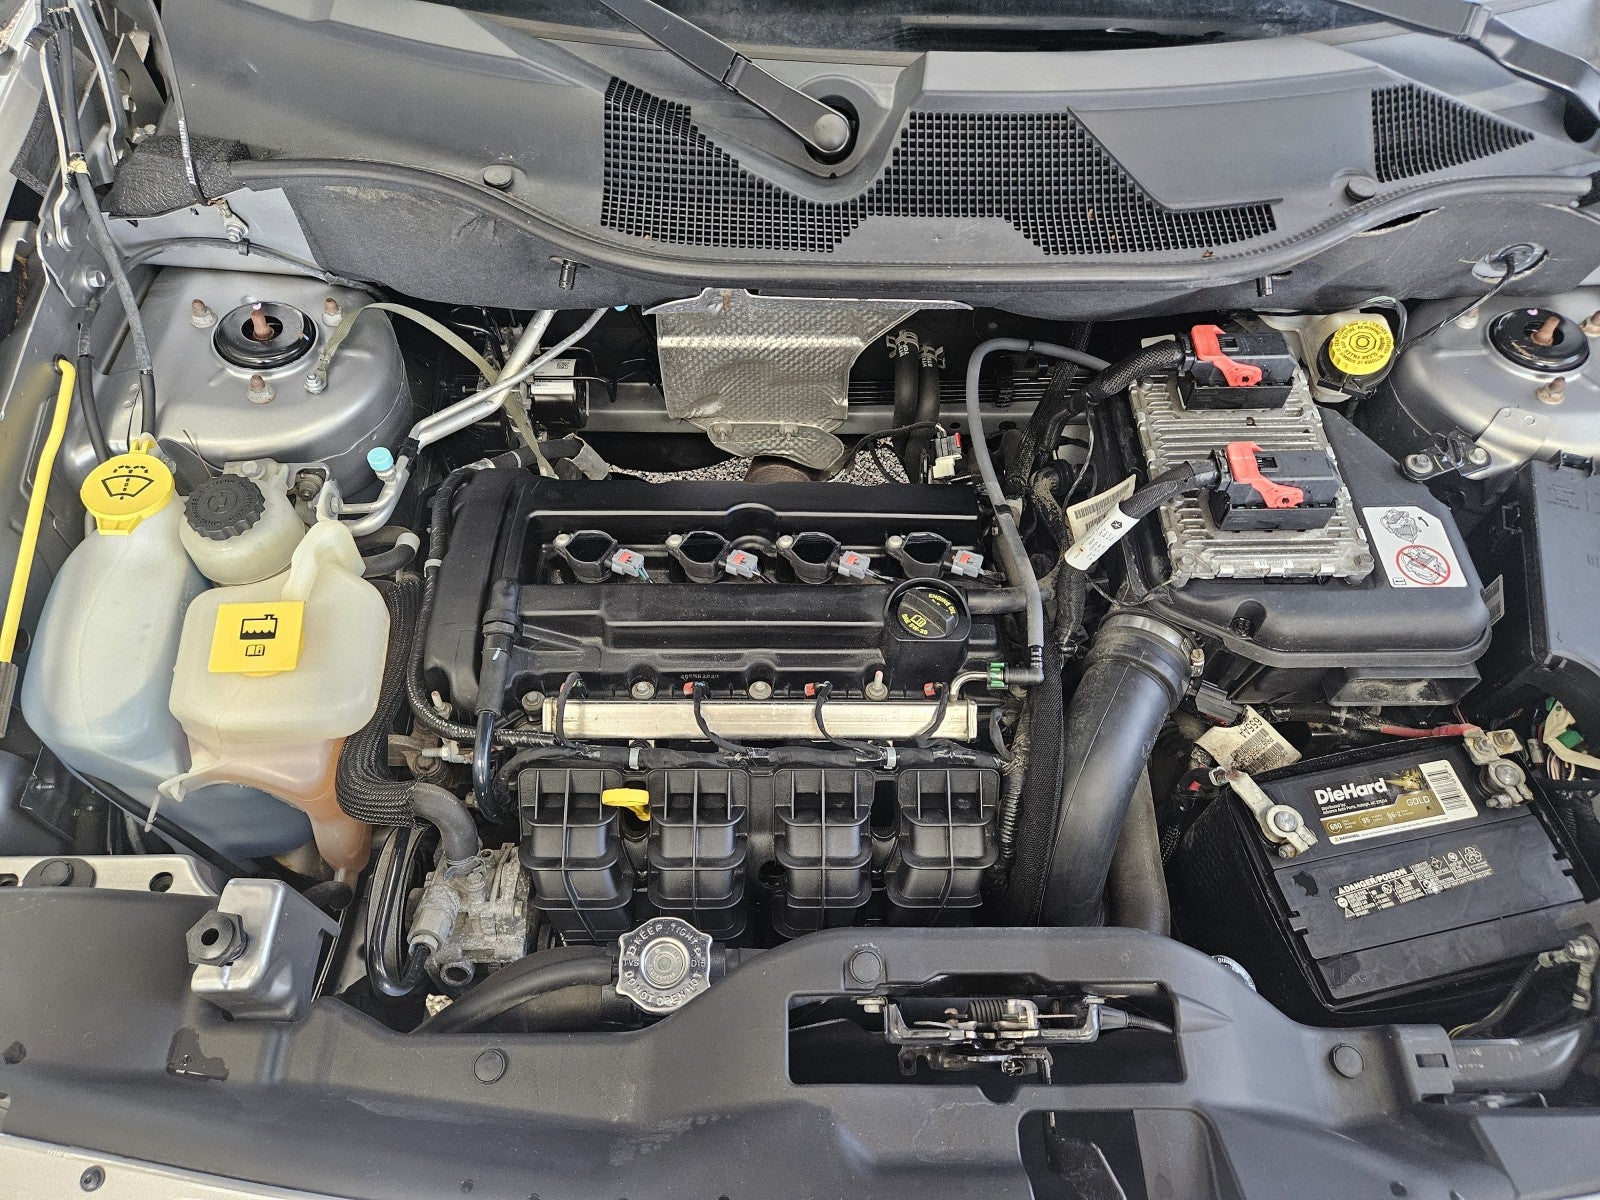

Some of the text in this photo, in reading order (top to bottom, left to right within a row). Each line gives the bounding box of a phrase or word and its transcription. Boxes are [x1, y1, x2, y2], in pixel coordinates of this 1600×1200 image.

[929, 593, 956, 614] ENGINE OIL
[901, 613, 928, 635] SAE 5W-20
[1239, 717, 1262, 738] 655AA
[1315, 778, 1387, 805] DieHard
[1407, 796, 1430, 806] GOLD
[1344, 868, 1406, 892] DANGER/POISON
[634, 923, 698, 945] KEEP TIGHT
[625, 971, 702, 1006] DO NOT OPEN HOT
